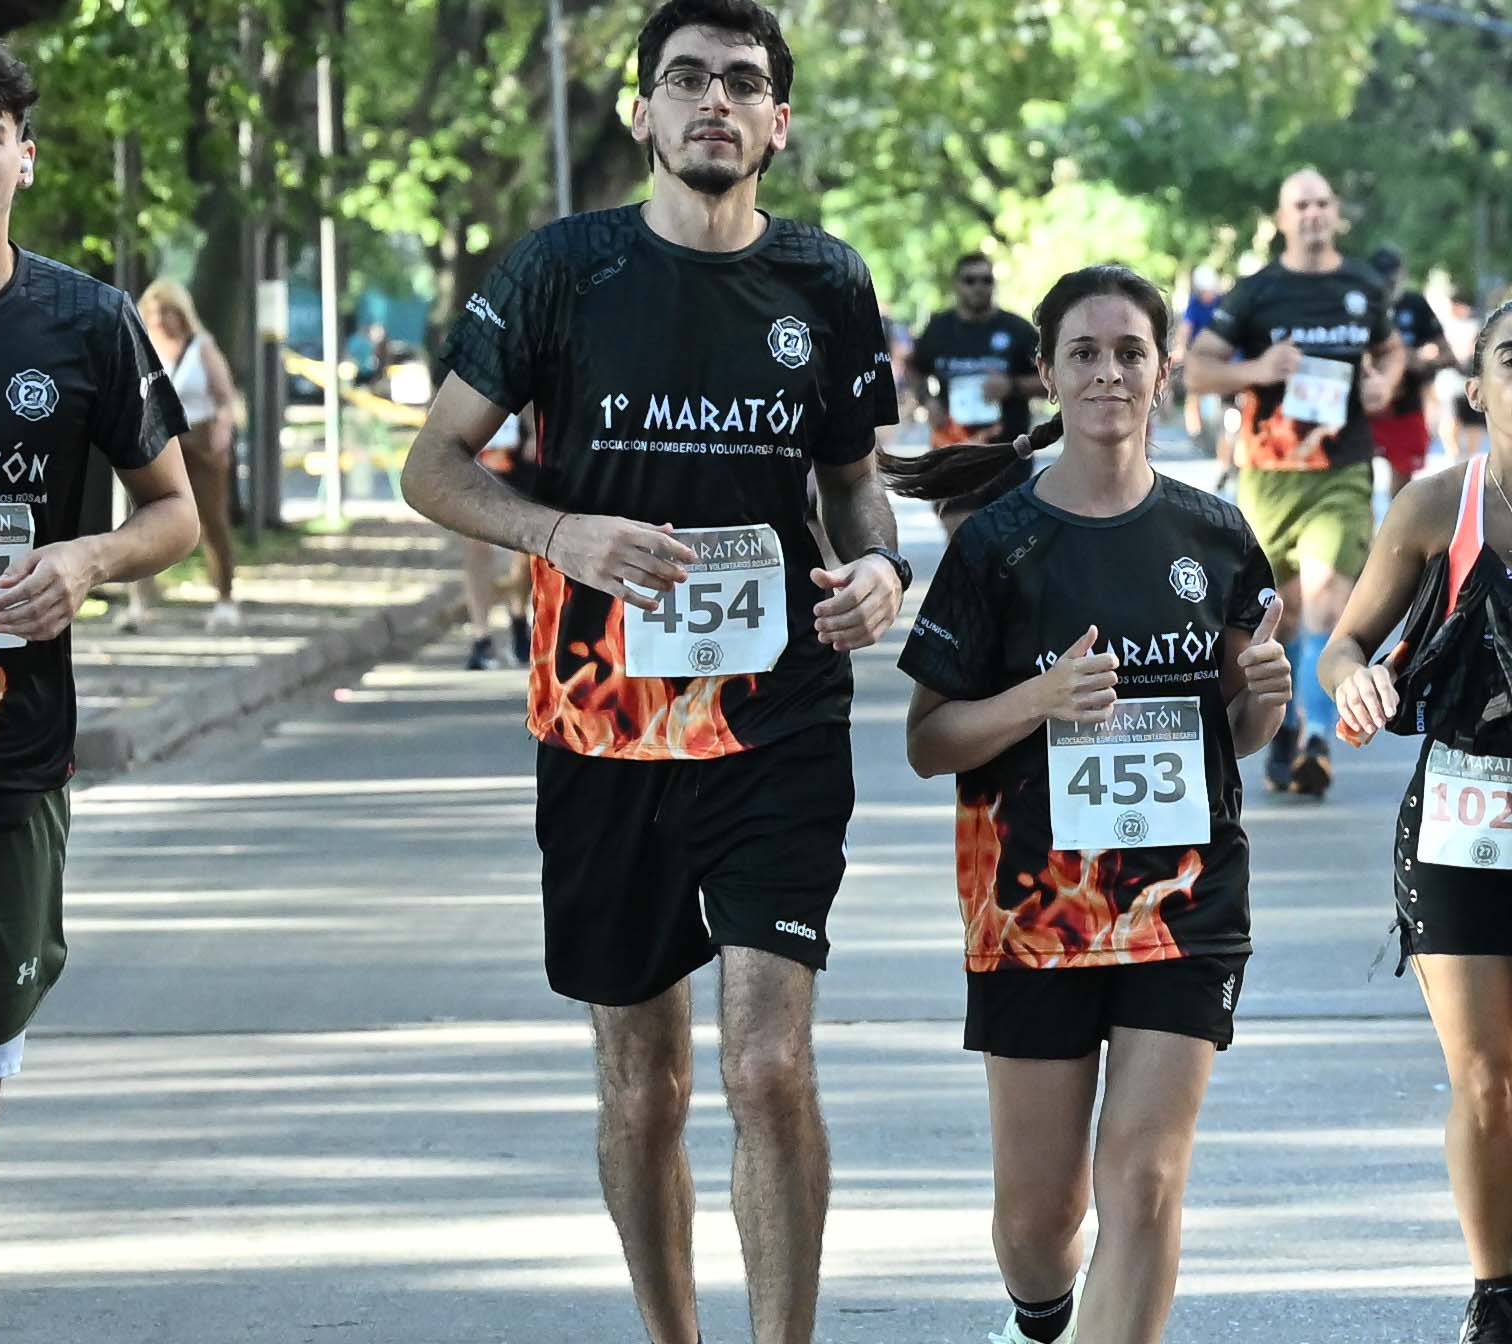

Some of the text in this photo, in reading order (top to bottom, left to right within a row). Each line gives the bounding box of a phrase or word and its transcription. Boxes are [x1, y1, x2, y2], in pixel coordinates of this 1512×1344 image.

[23, 384, 44, 402] 27
[649, 440, 707, 454] BOMBEROS
[690, 533, 763, 560] ARATÓN
[642, 579, 765, 634] 454
[1067, 752, 1186, 806] 453
[1124, 821, 1139, 834] 27
[775, 920, 817, 941] adidas
[1222, 972, 1236, 1011] nike
